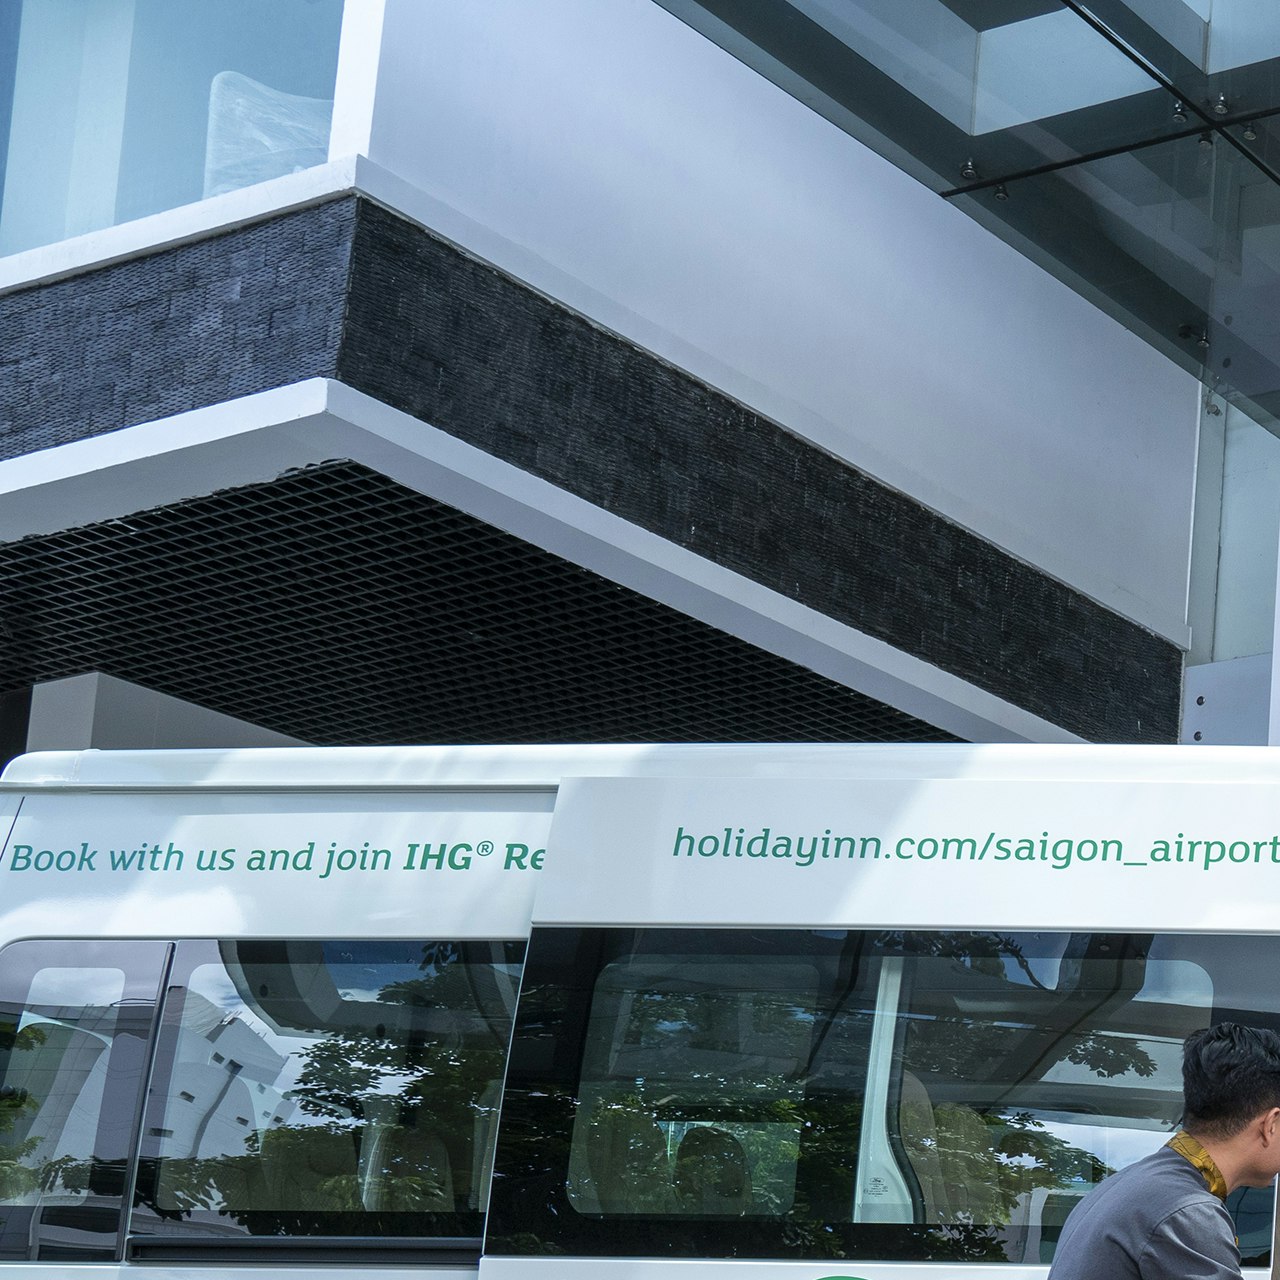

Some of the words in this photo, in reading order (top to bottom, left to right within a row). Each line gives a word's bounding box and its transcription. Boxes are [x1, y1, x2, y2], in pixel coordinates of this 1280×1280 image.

[10, 842, 98, 872] Book
[110, 842, 184, 872] with
[196, 848, 236, 872] us
[246, 842, 315, 872] and
[319, 842, 392, 879] join
[504, 843, 546, 870] Re
